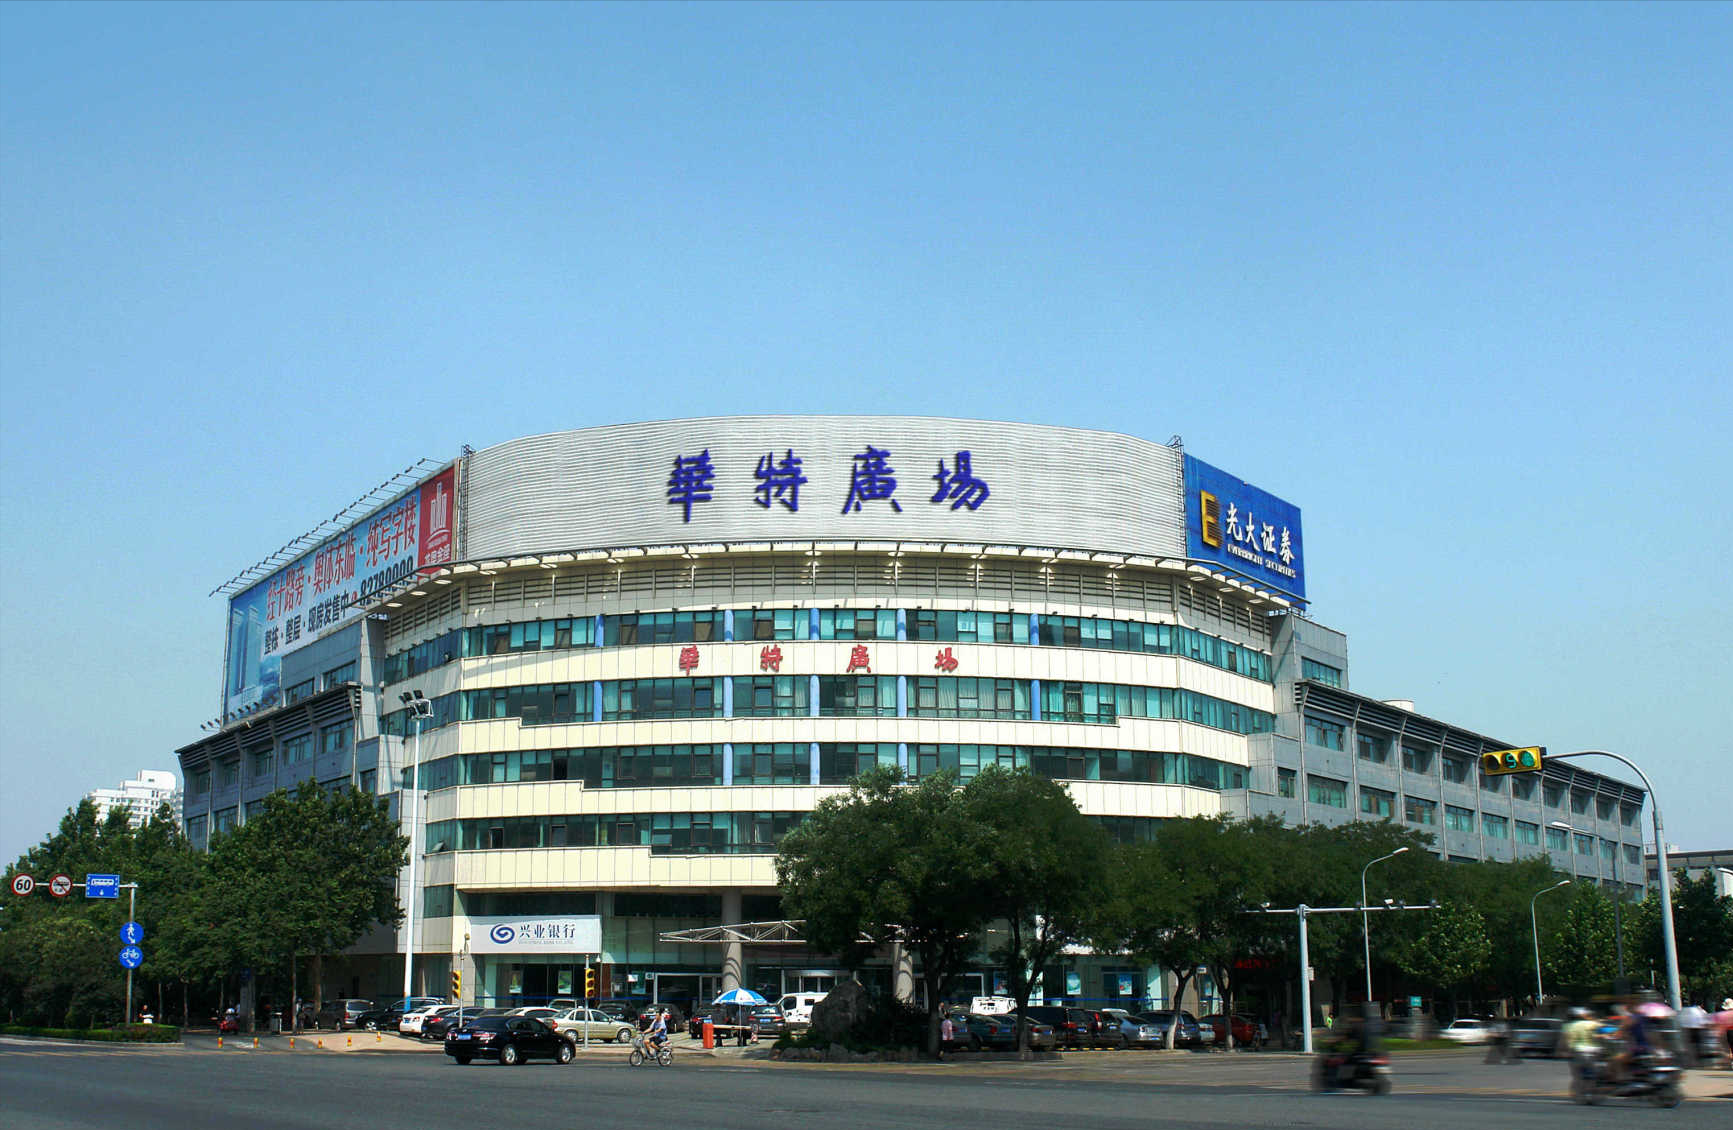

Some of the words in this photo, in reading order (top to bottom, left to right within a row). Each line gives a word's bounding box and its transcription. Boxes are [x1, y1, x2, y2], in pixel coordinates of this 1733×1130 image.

[667, 445, 990, 522] 華特廣場
[1226, 502, 1295, 565] 光大证券
[679, 644, 959, 676] 華特廣場
[16, 880, 31, 890] 60
[520, 923, 576, 938] 兴业银行
